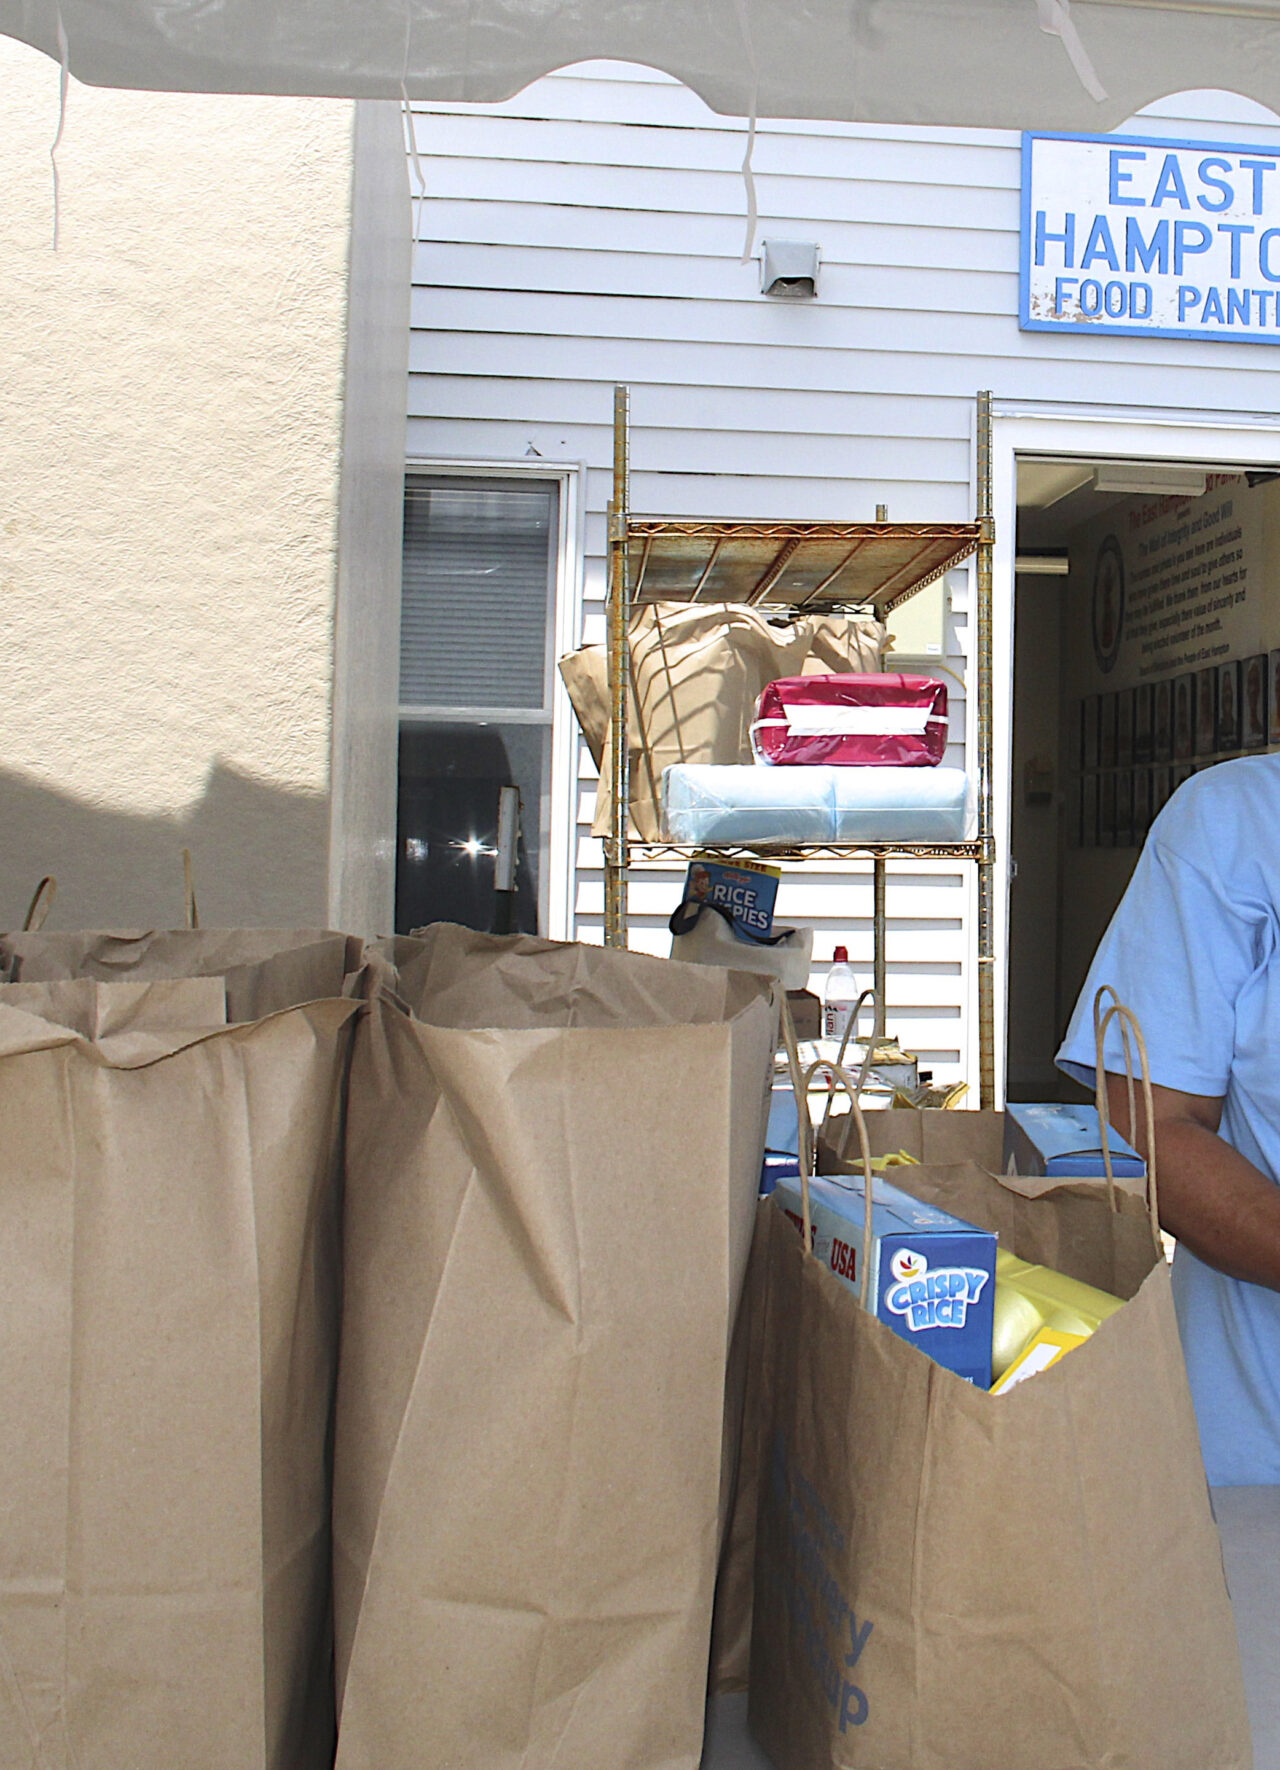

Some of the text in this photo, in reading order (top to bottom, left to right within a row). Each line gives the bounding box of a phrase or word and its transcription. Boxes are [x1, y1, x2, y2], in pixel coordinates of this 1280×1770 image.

[1108, 150, 1277, 215] EAST
[1055, 276, 1152, 319] FOOD
[714, 884, 756, 907] RICE
[831, 1238, 856, 1282] USA
[891, 1271, 987, 1311] CRISPY
[911, 1300, 966, 1328] RICE
